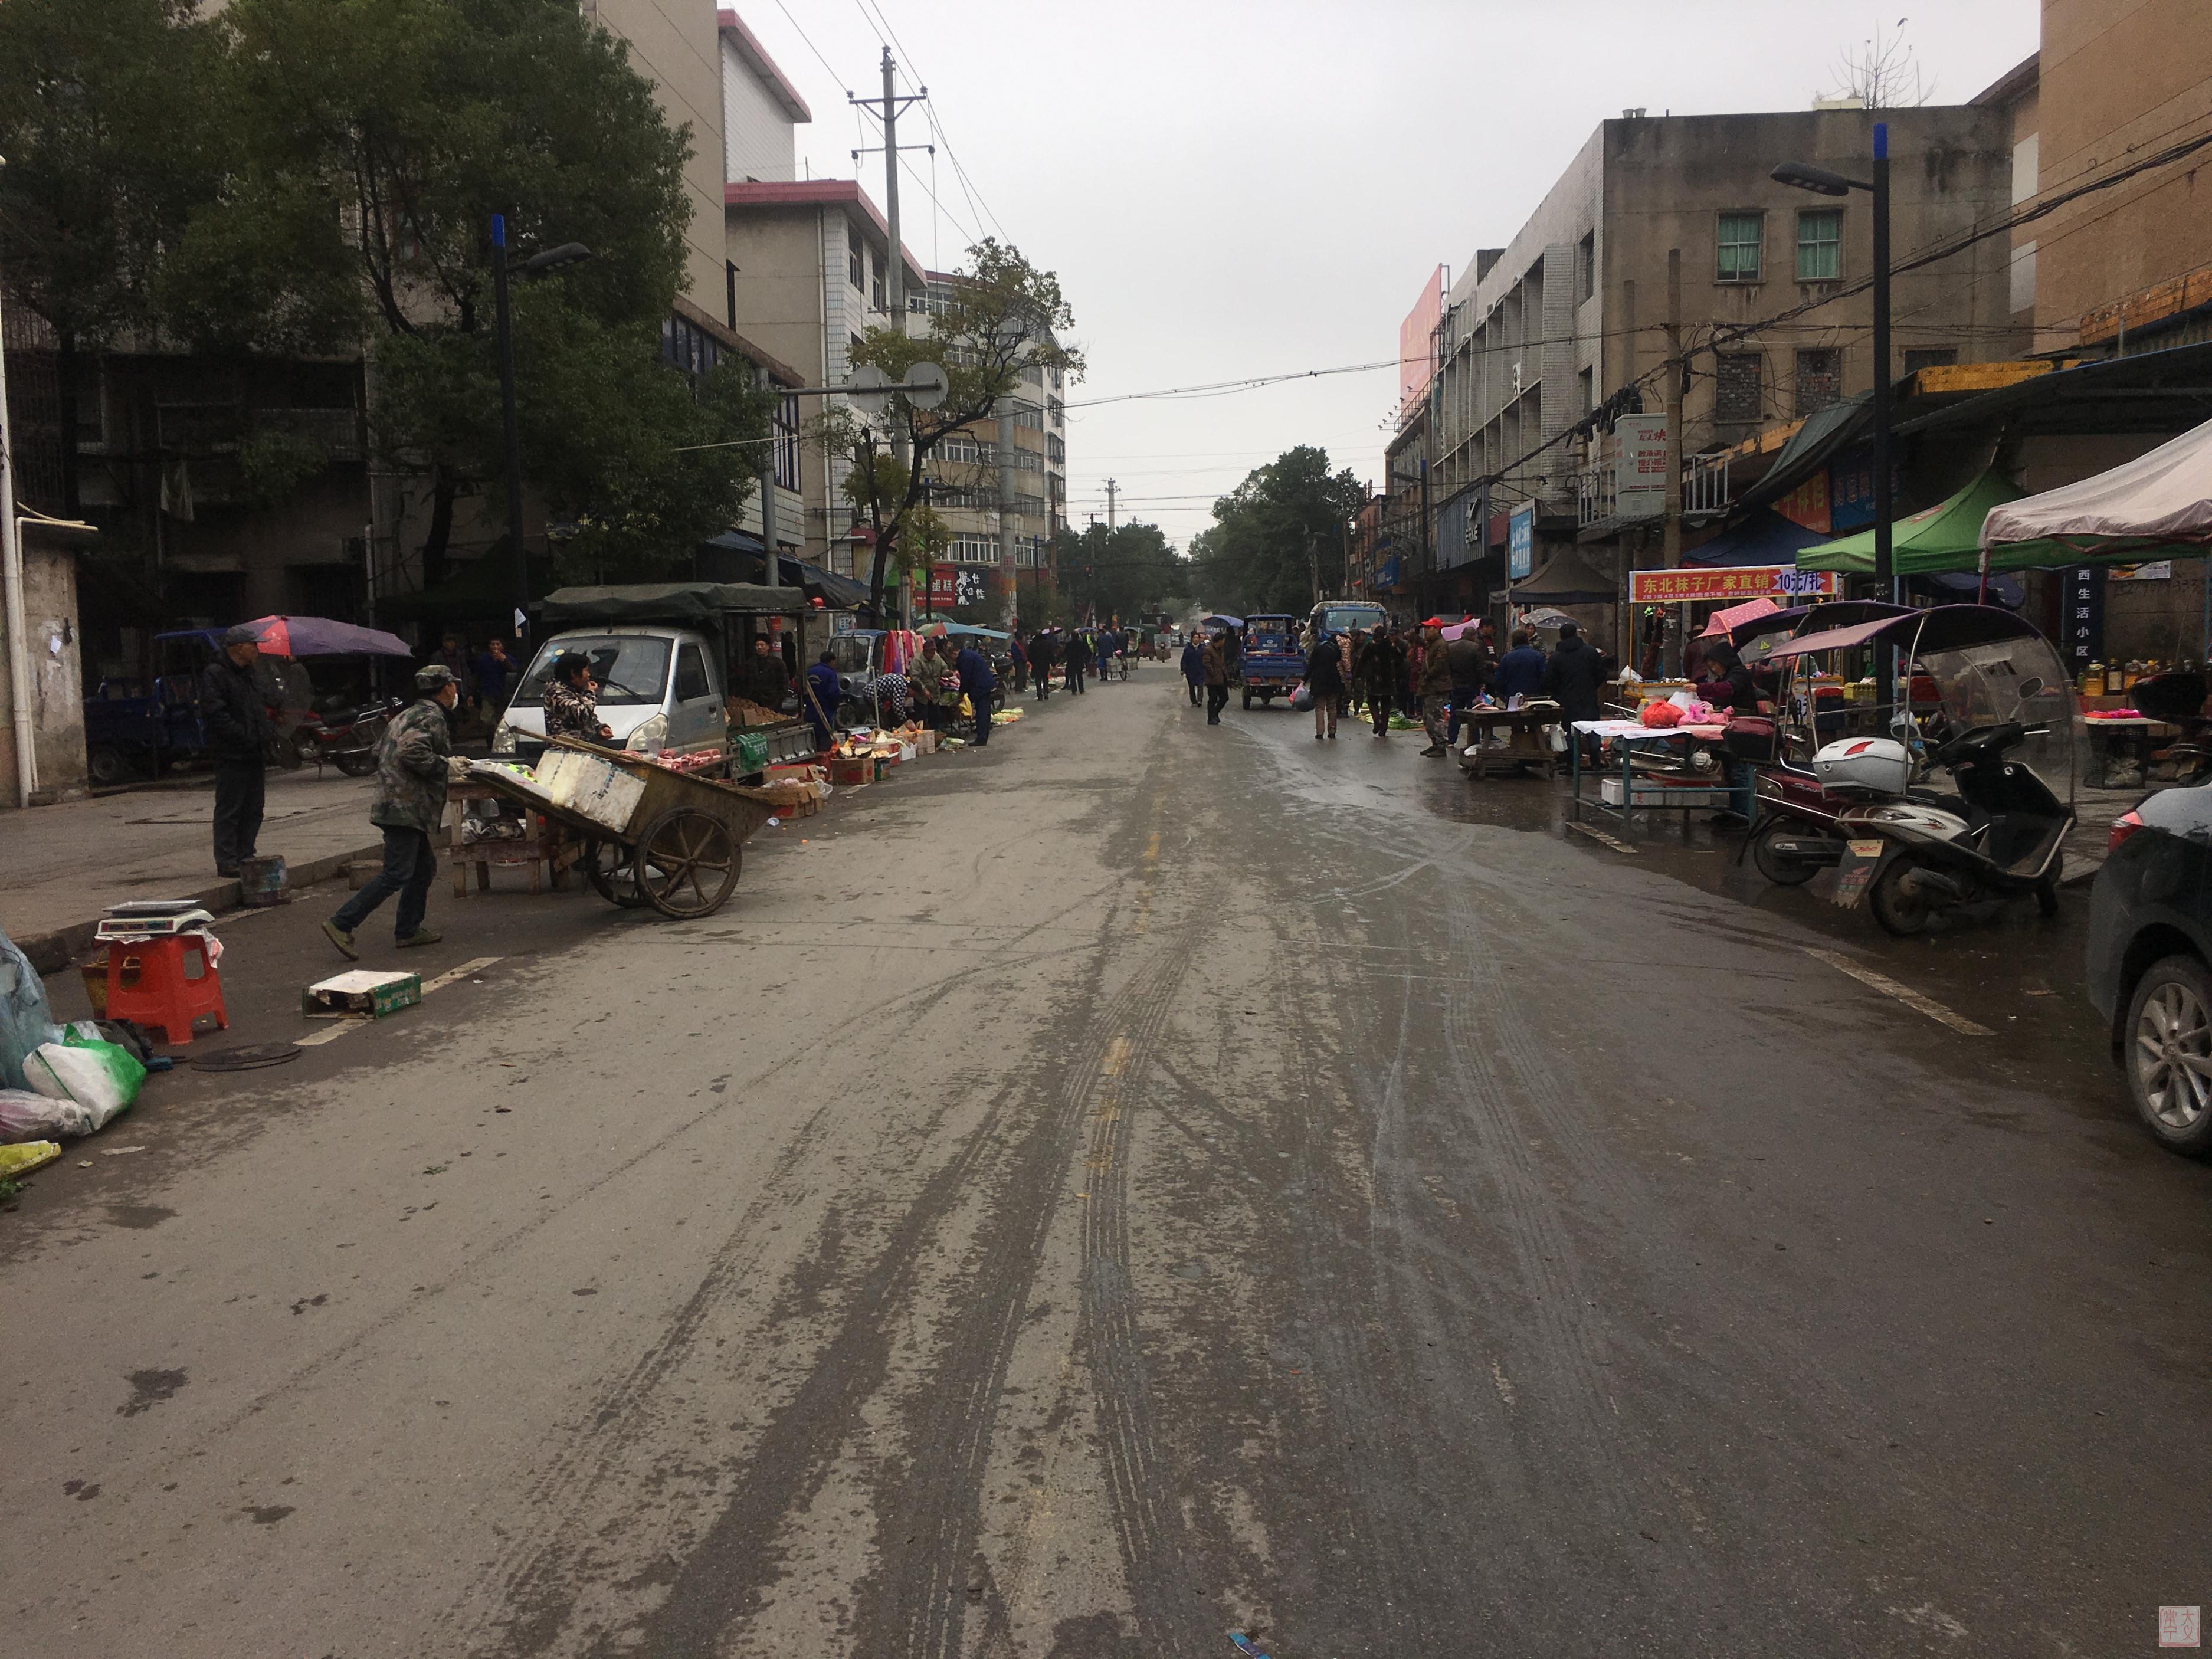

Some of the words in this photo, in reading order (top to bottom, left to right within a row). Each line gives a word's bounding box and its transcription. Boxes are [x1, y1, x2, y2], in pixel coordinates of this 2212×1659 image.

[1644, 574, 1769, 594] 东北袜子厂家直销
[2076, 569, 2091, 657] 西生活小区
